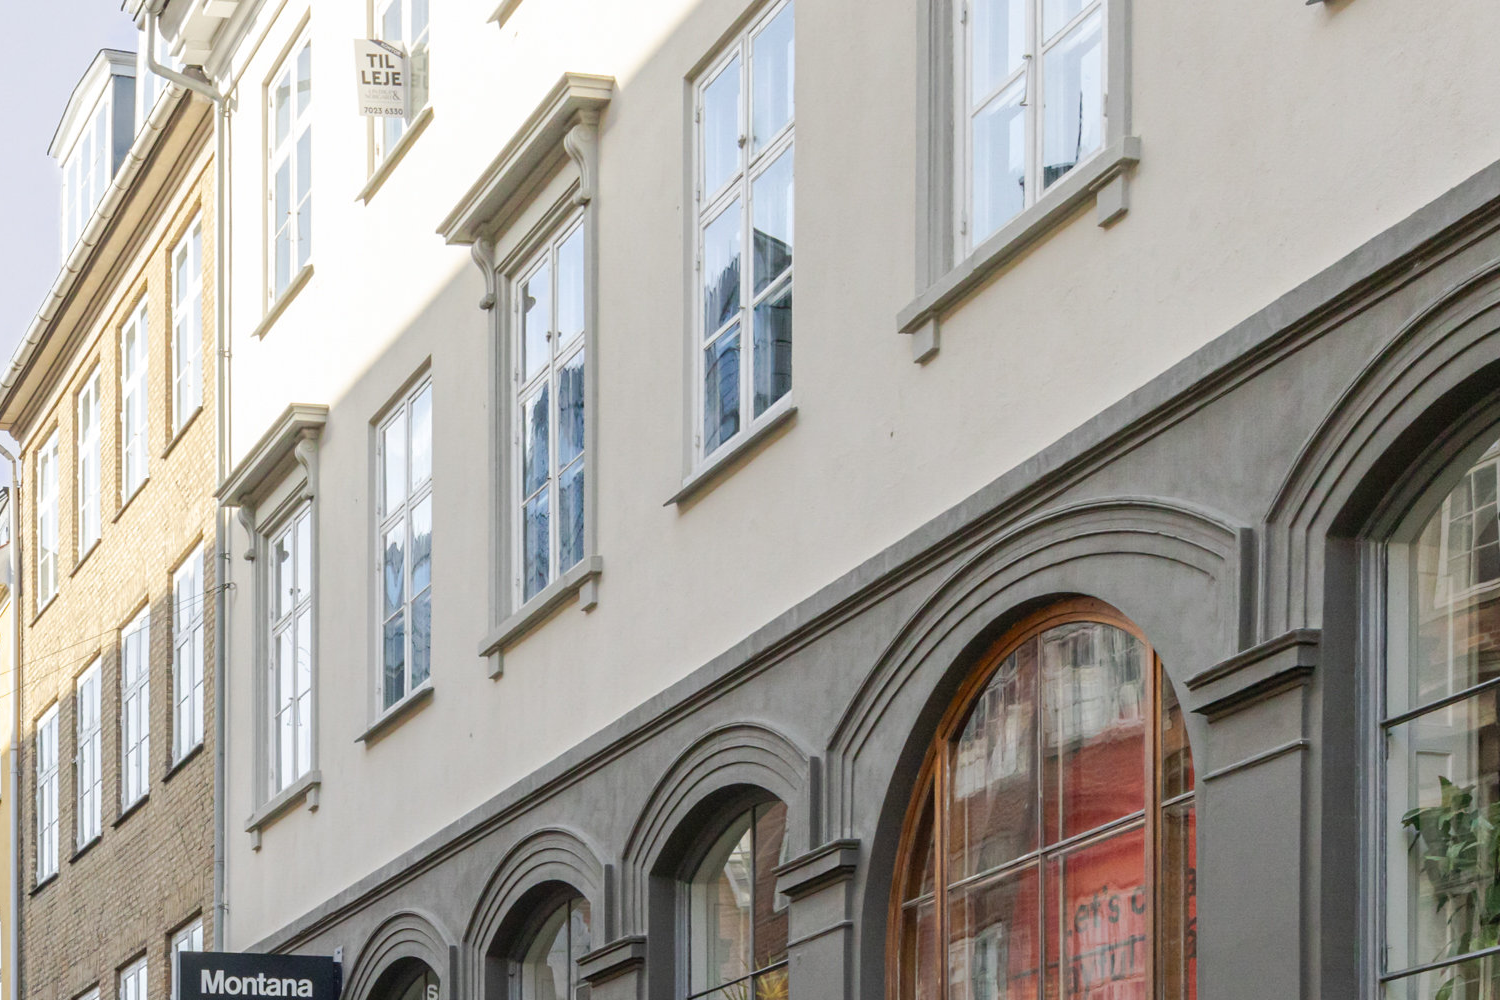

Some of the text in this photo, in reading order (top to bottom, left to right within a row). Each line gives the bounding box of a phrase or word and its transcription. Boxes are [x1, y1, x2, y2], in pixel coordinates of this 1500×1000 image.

[366, 53, 395, 69] TIL
[361, 70, 402, 86] LEJE
[200, 969, 313, 998] Montana
